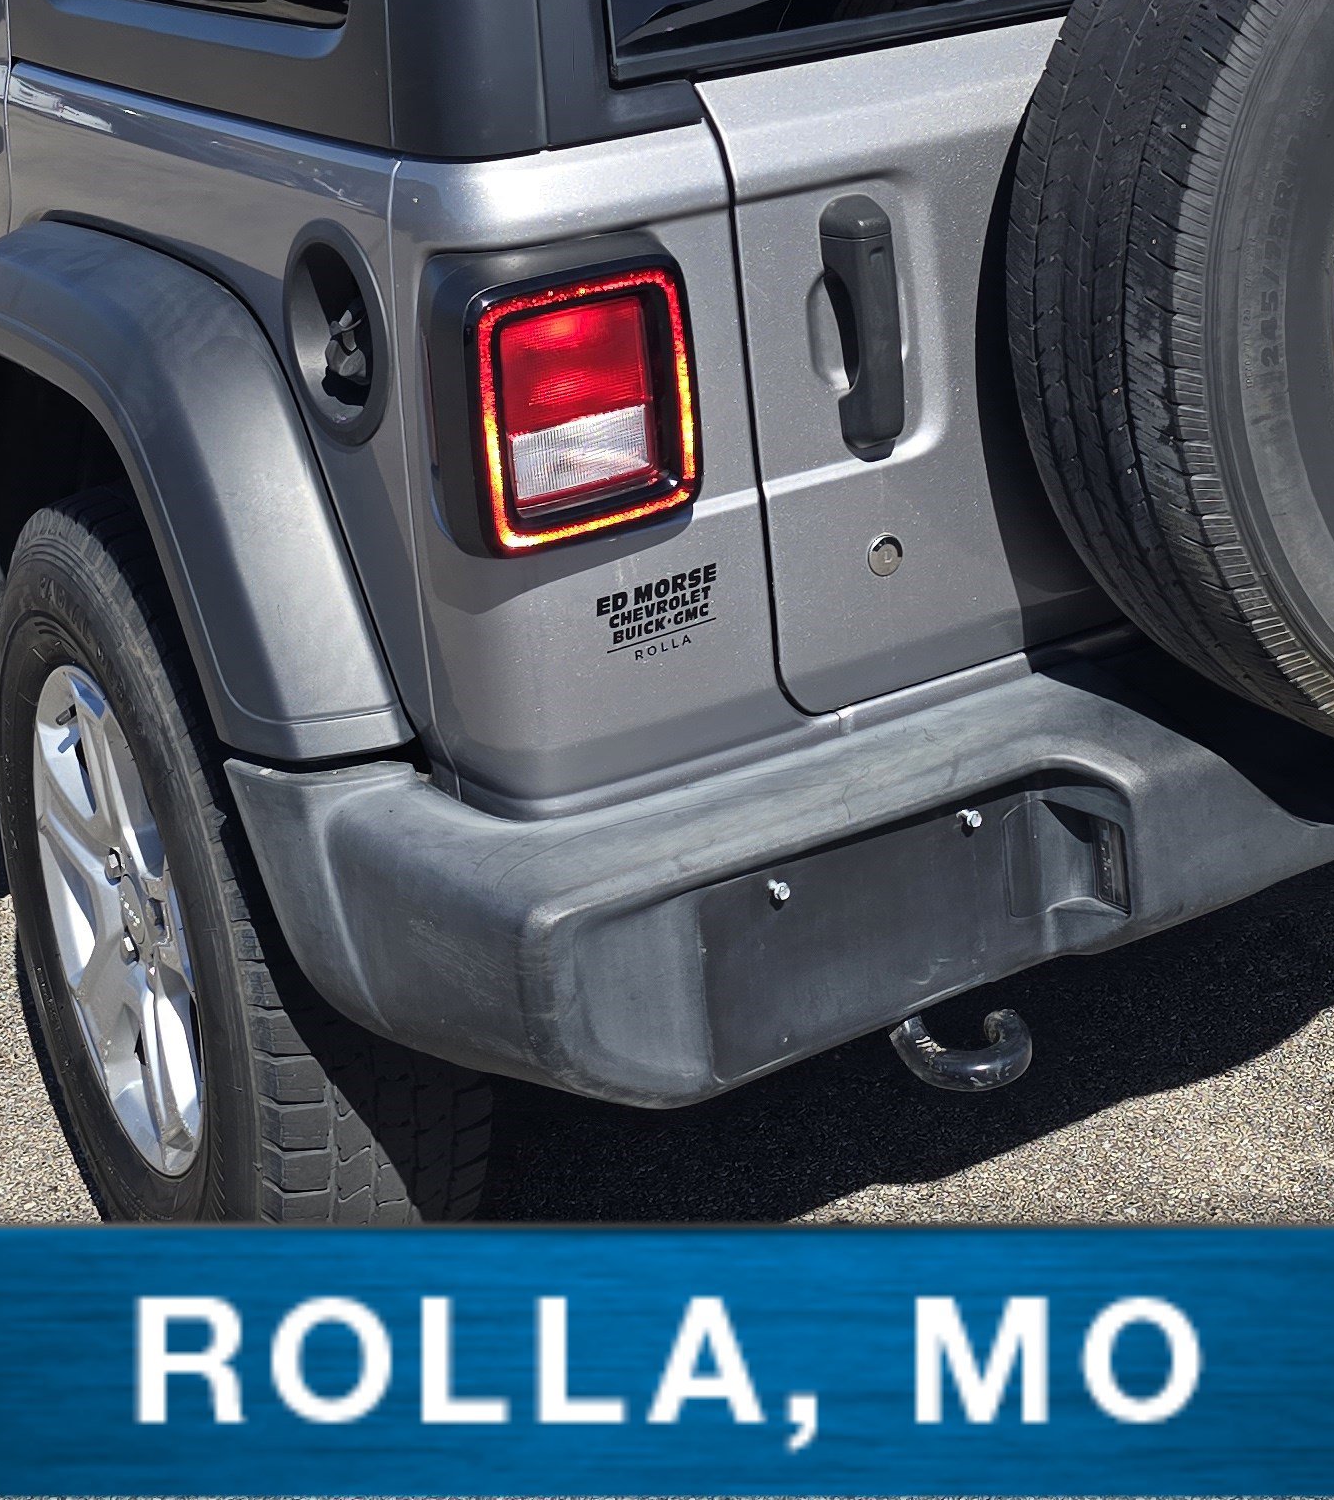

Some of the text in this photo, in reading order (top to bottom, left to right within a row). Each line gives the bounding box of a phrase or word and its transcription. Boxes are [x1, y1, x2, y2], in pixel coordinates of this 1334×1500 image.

[597, 562, 717, 617] ED MORSE
[609, 585, 711, 629] CHEVROLET
[634, 634, 692, 661] ROLLA
